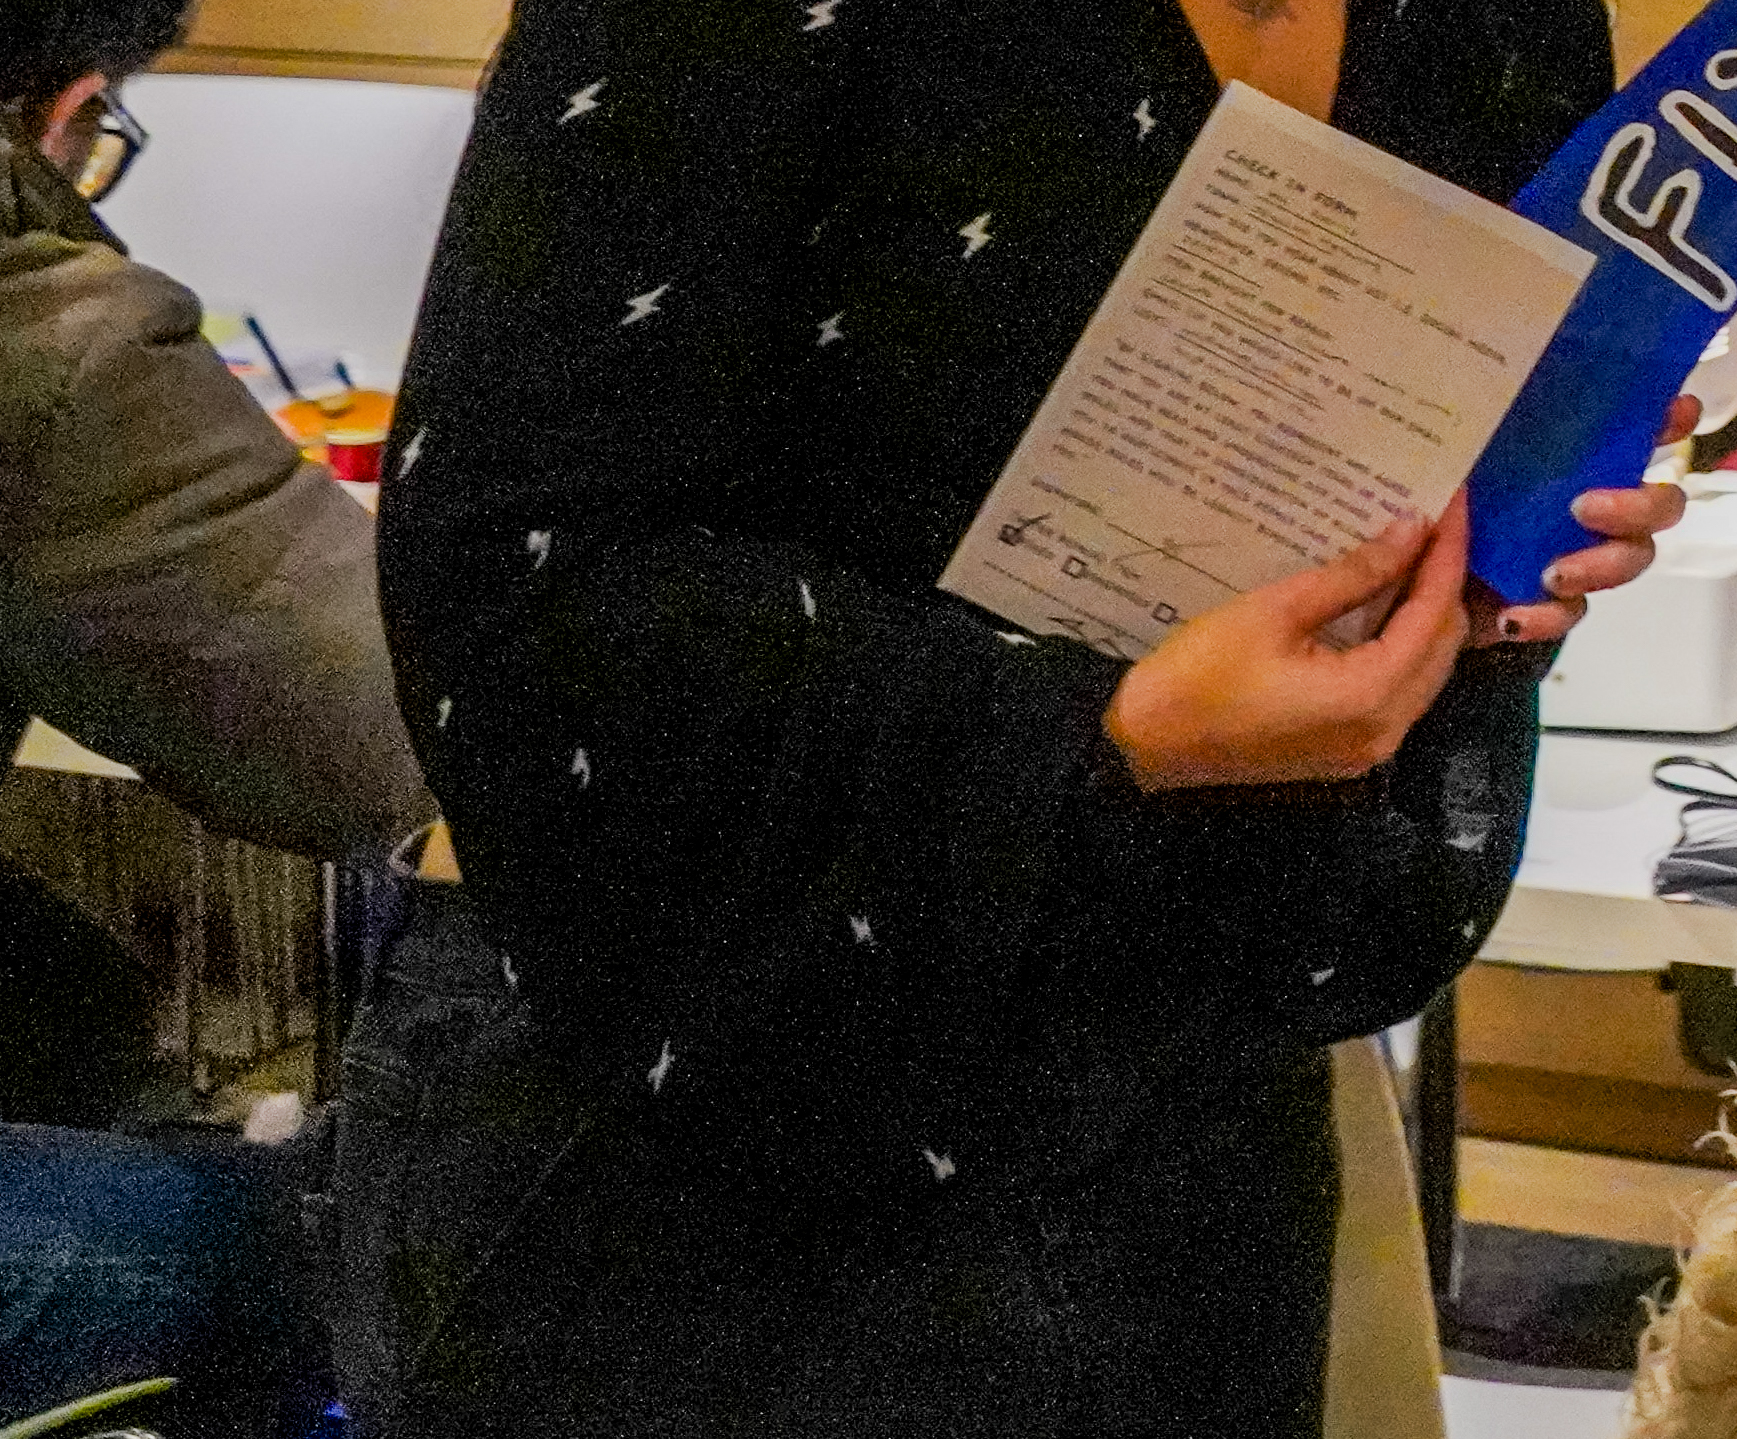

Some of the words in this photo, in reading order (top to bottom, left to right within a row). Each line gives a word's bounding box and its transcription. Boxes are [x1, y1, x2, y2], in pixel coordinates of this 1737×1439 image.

[1222, 146, 1281, 182] CHECK
[1283, 176, 1309, 196] IN
[1310, 189, 1361, 221] FORM
